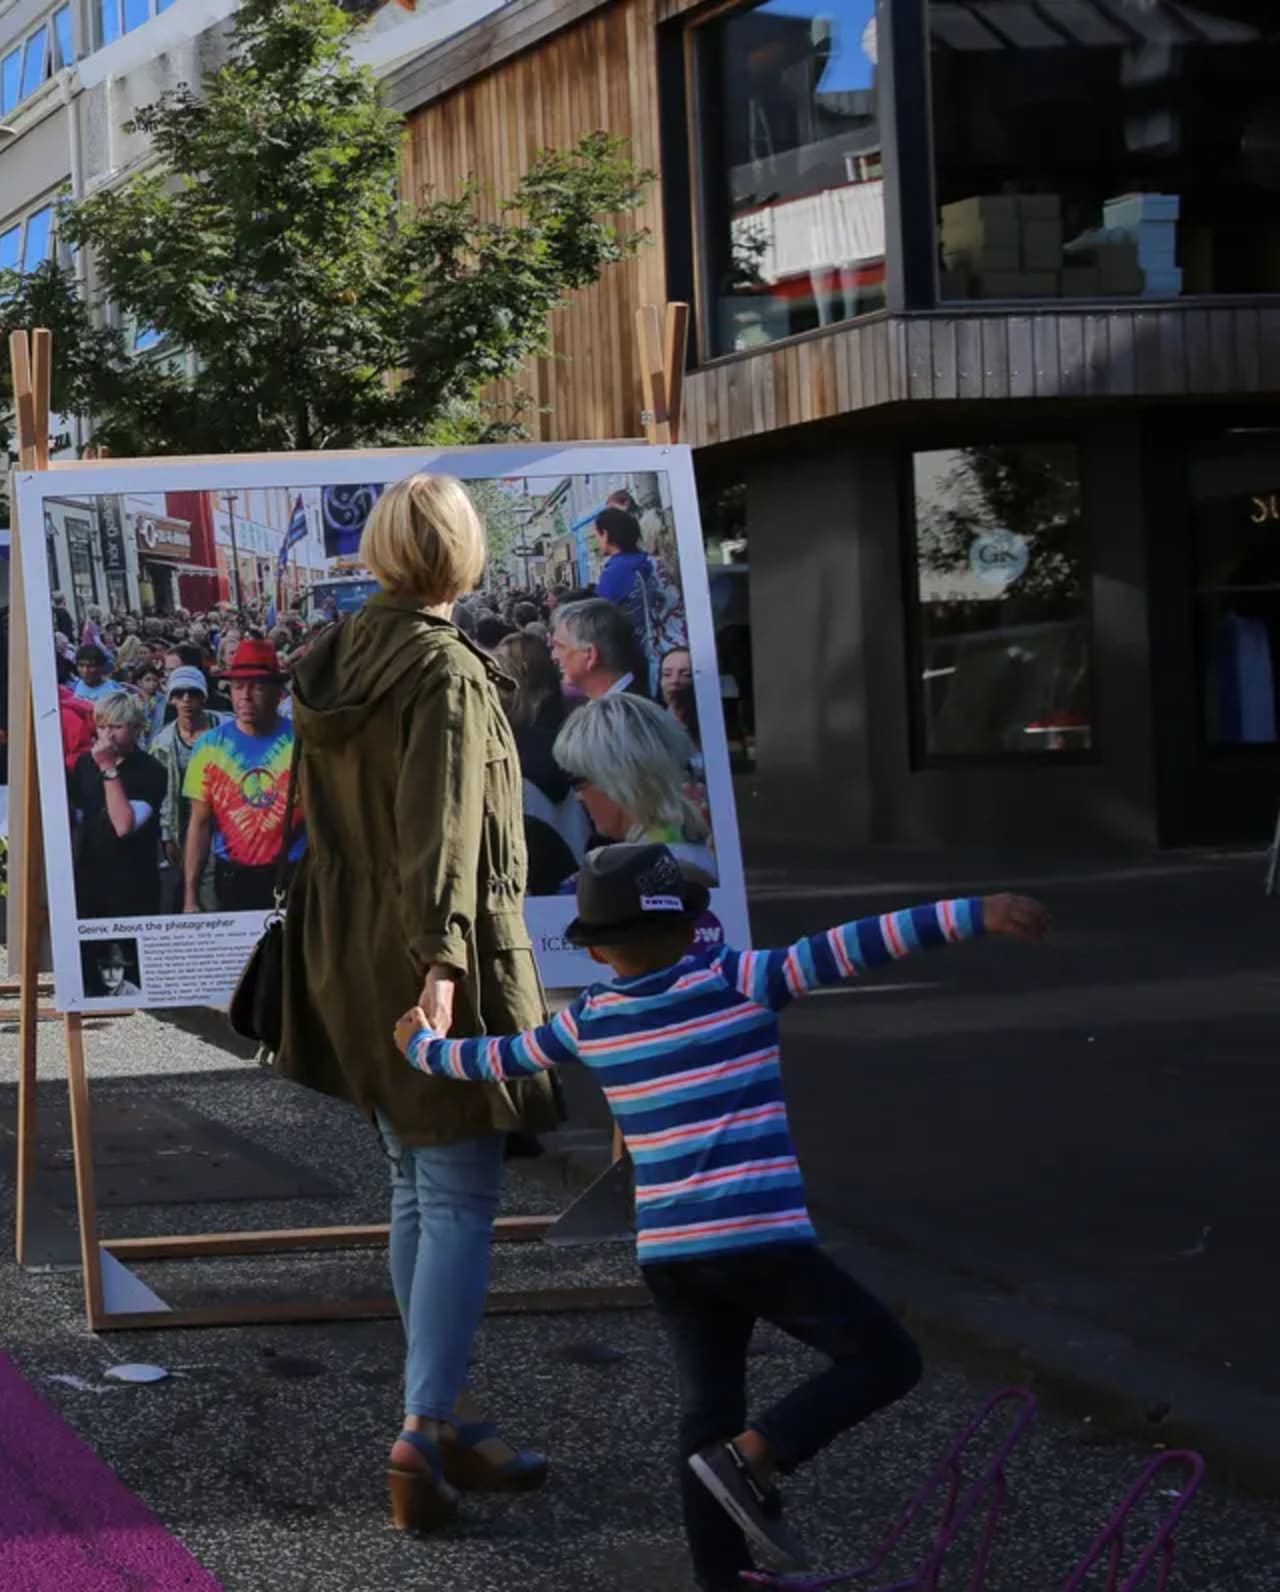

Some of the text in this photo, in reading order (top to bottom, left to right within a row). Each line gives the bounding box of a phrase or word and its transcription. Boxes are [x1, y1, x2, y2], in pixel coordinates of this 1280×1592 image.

[112, 923, 143, 933] About
[145, 922, 163, 931] the
[165, 918, 236, 933] photographer
